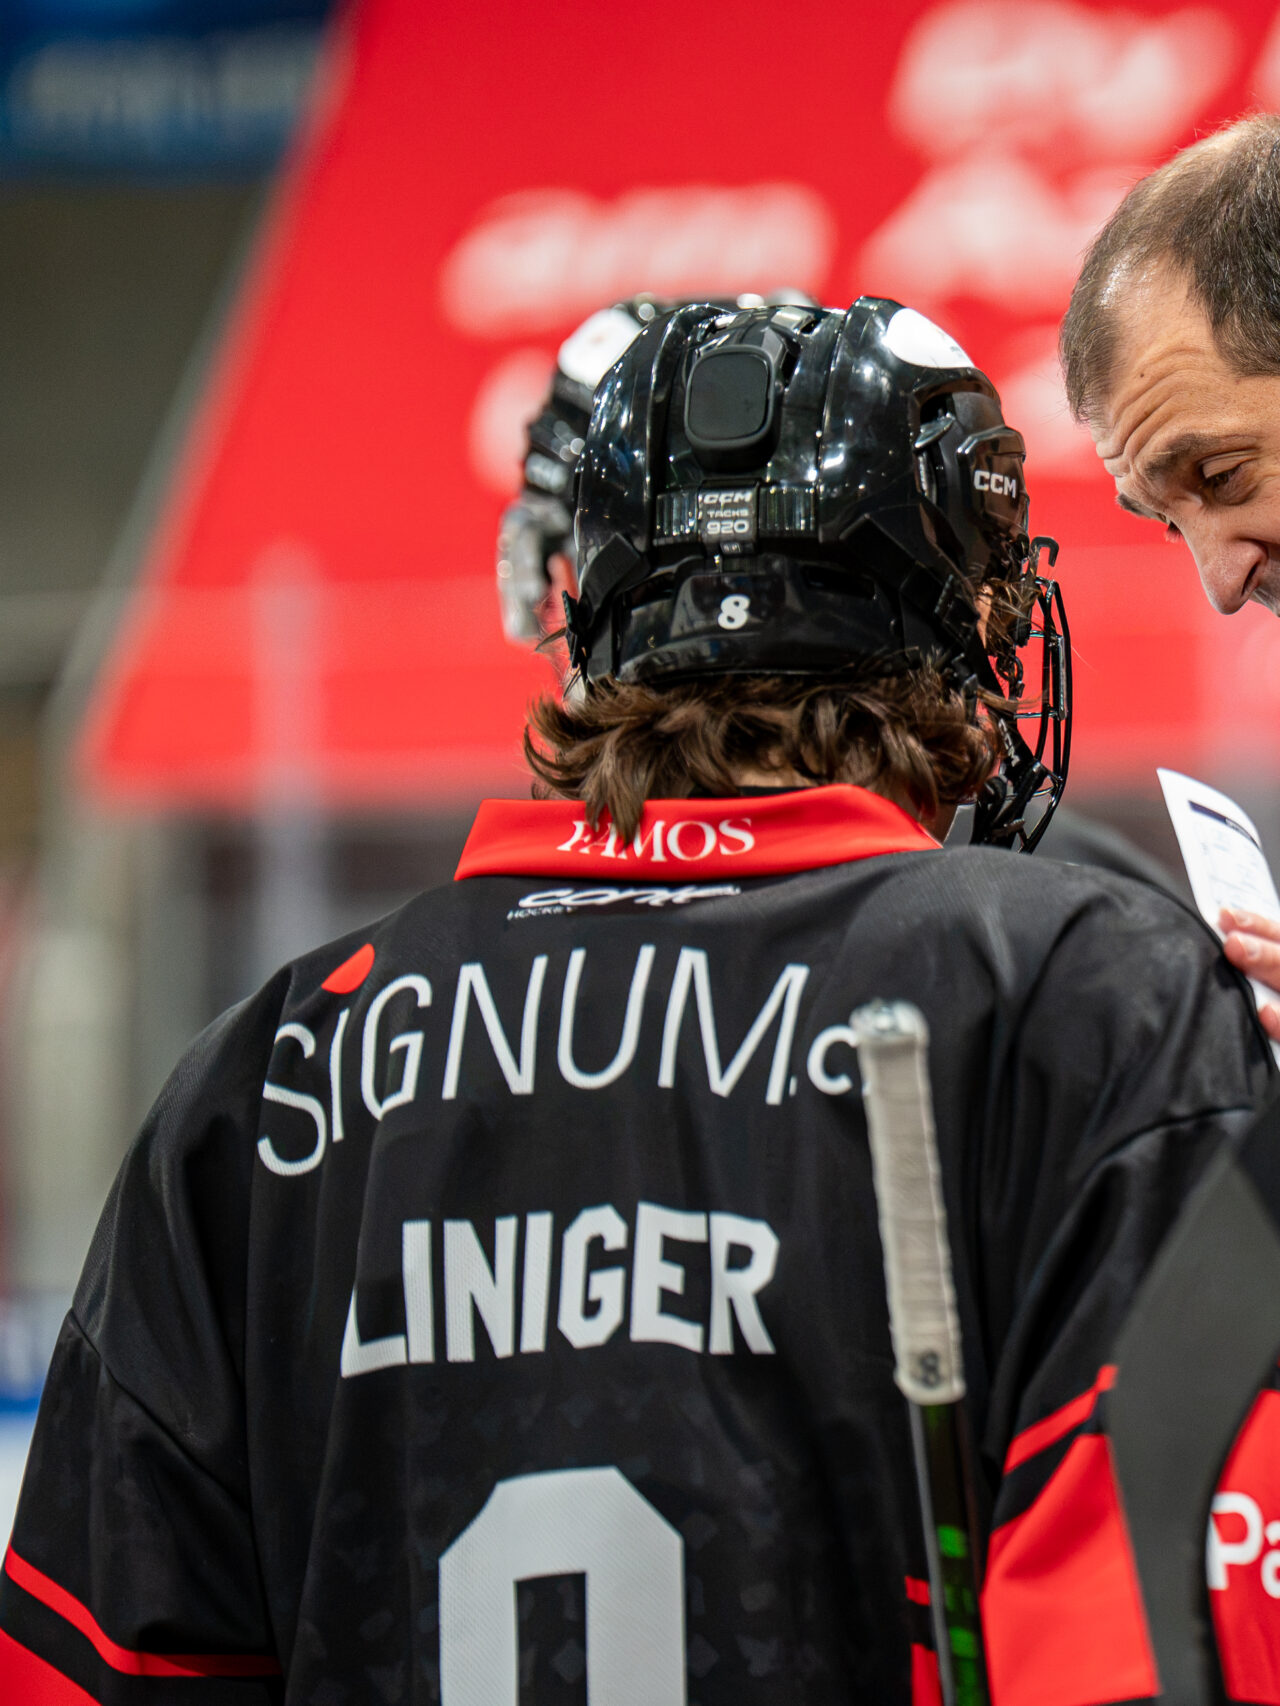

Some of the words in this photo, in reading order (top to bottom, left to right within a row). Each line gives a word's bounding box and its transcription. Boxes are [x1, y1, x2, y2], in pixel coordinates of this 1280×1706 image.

[974, 470, 1017, 498] CCM
[703, 492, 752, 504] CCM
[707, 509, 749, 518] TACKS
[706, 520, 749, 534] 920
[717, 594, 750, 630] 8
[341, 1201, 780, 1378] LINIGER
